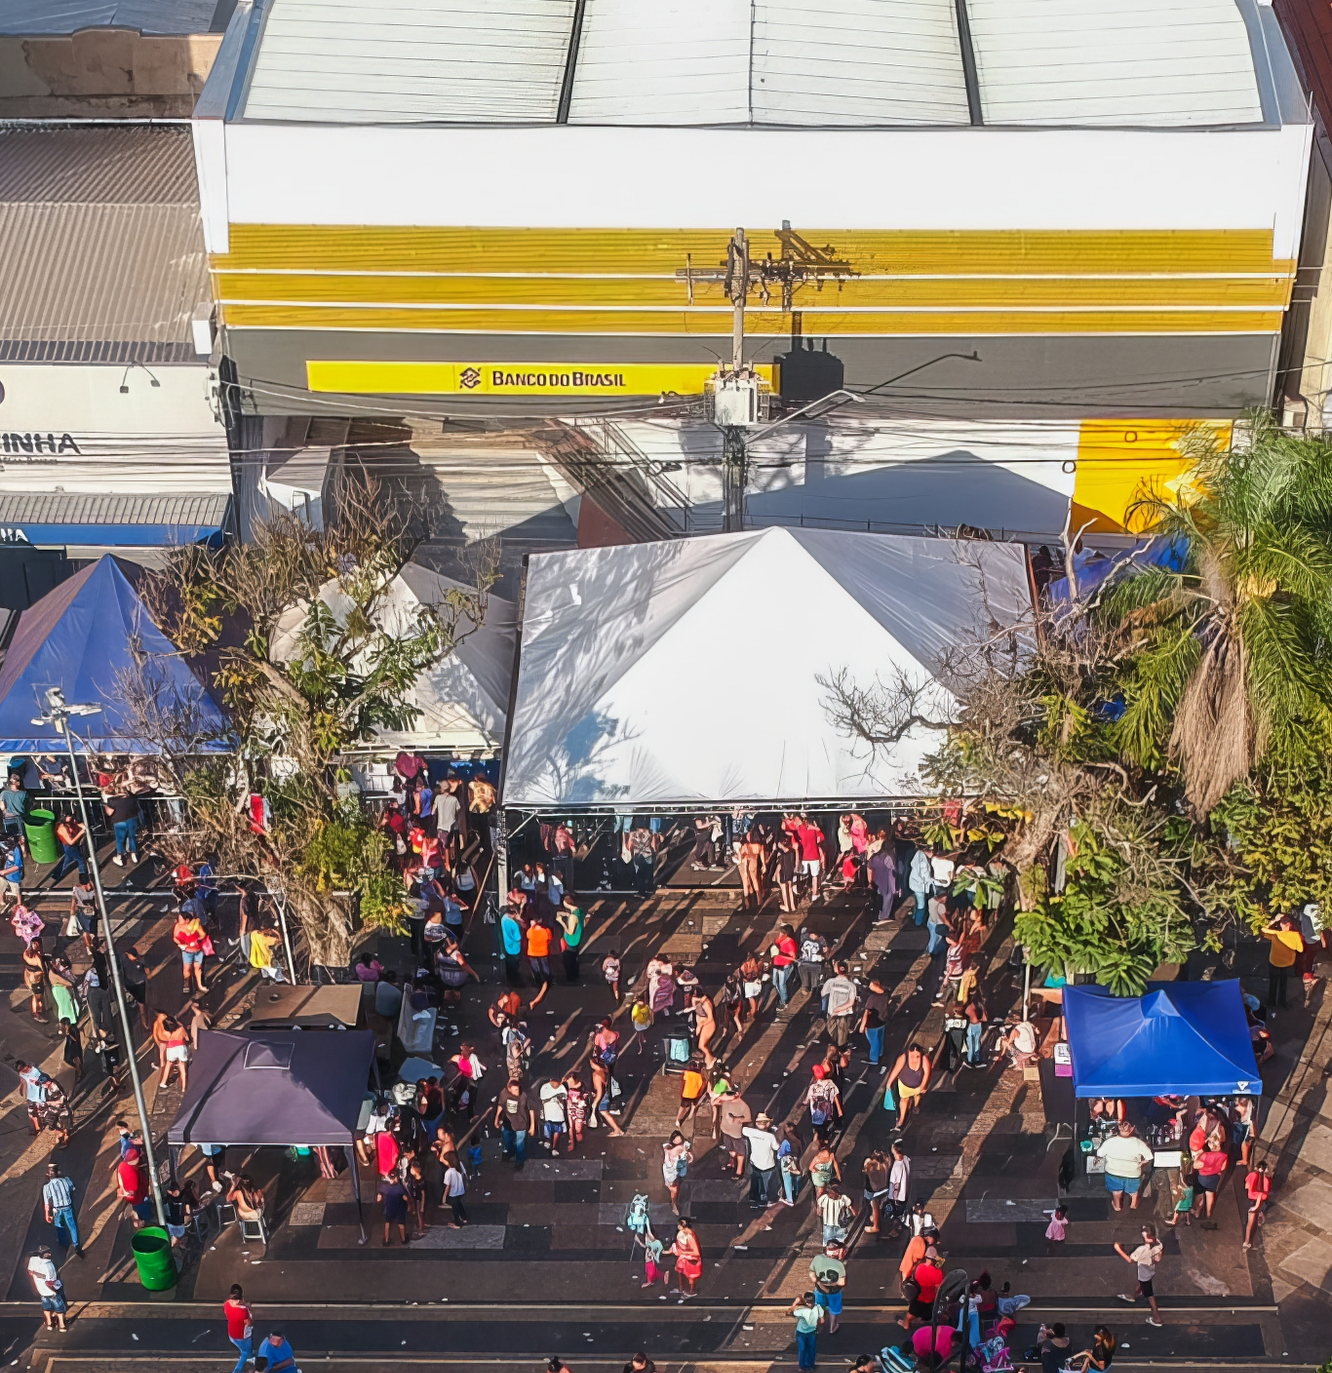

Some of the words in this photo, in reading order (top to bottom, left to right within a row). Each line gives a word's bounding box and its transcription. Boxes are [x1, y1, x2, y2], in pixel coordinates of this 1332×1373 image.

[492, 371, 547, 386] BANCO
[550, 373, 569, 386] DO
[573, 372, 626, 387] BRASIL
